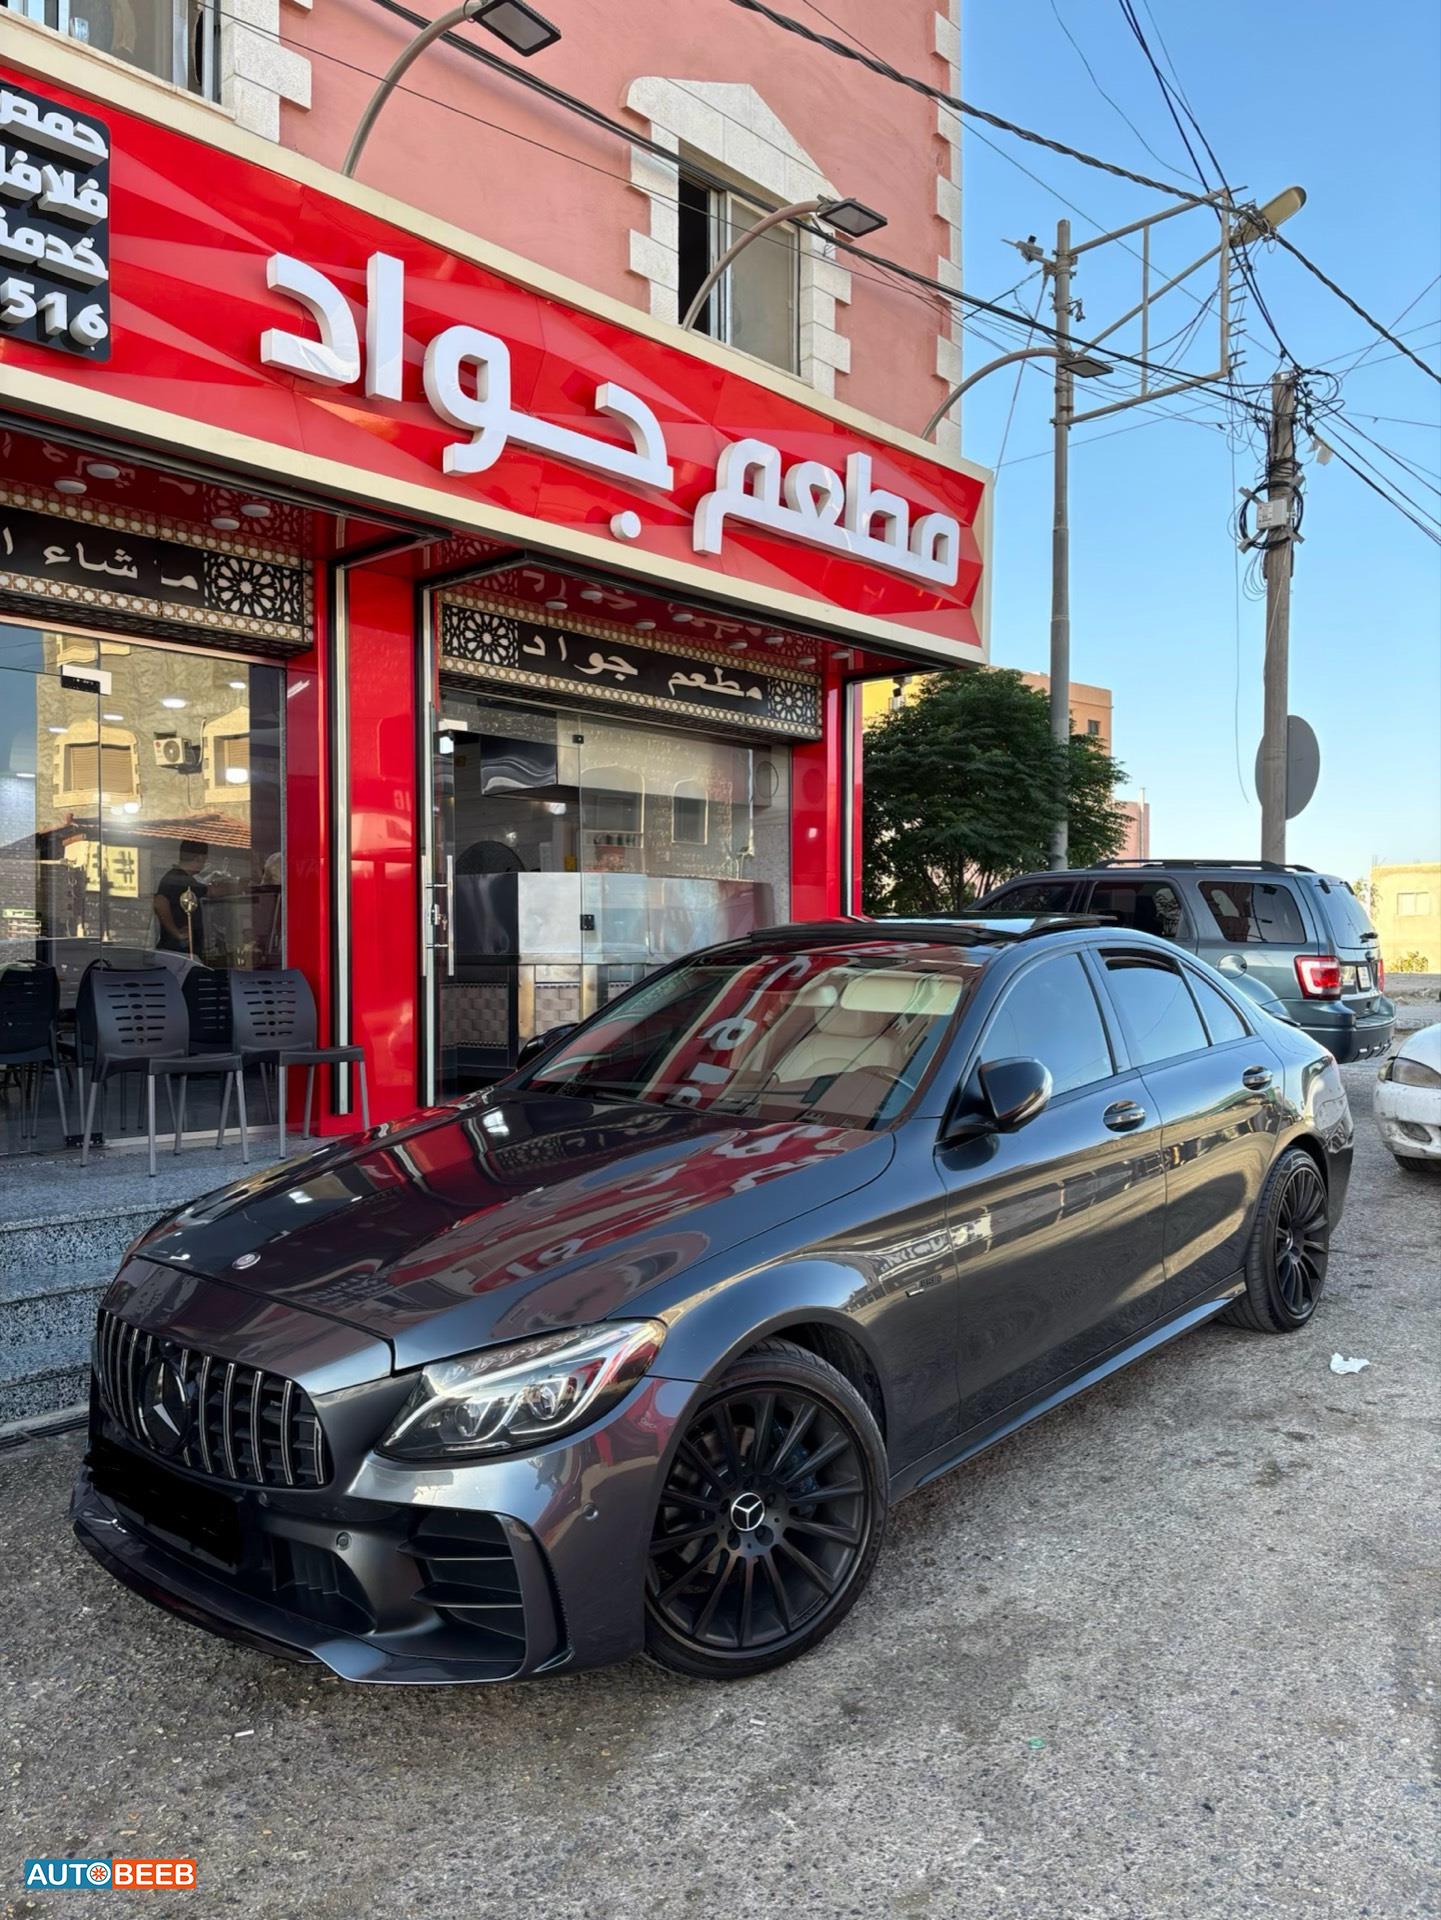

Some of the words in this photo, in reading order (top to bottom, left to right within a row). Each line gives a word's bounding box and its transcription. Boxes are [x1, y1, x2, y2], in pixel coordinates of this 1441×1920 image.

[259, 250, 675, 541] جواد
[692, 437, 961, 588] مطعم
[42, 541, 139, 580] شاء
[522, 634, 639, 682] جواد
[666, 665, 763, 701] مطعم
